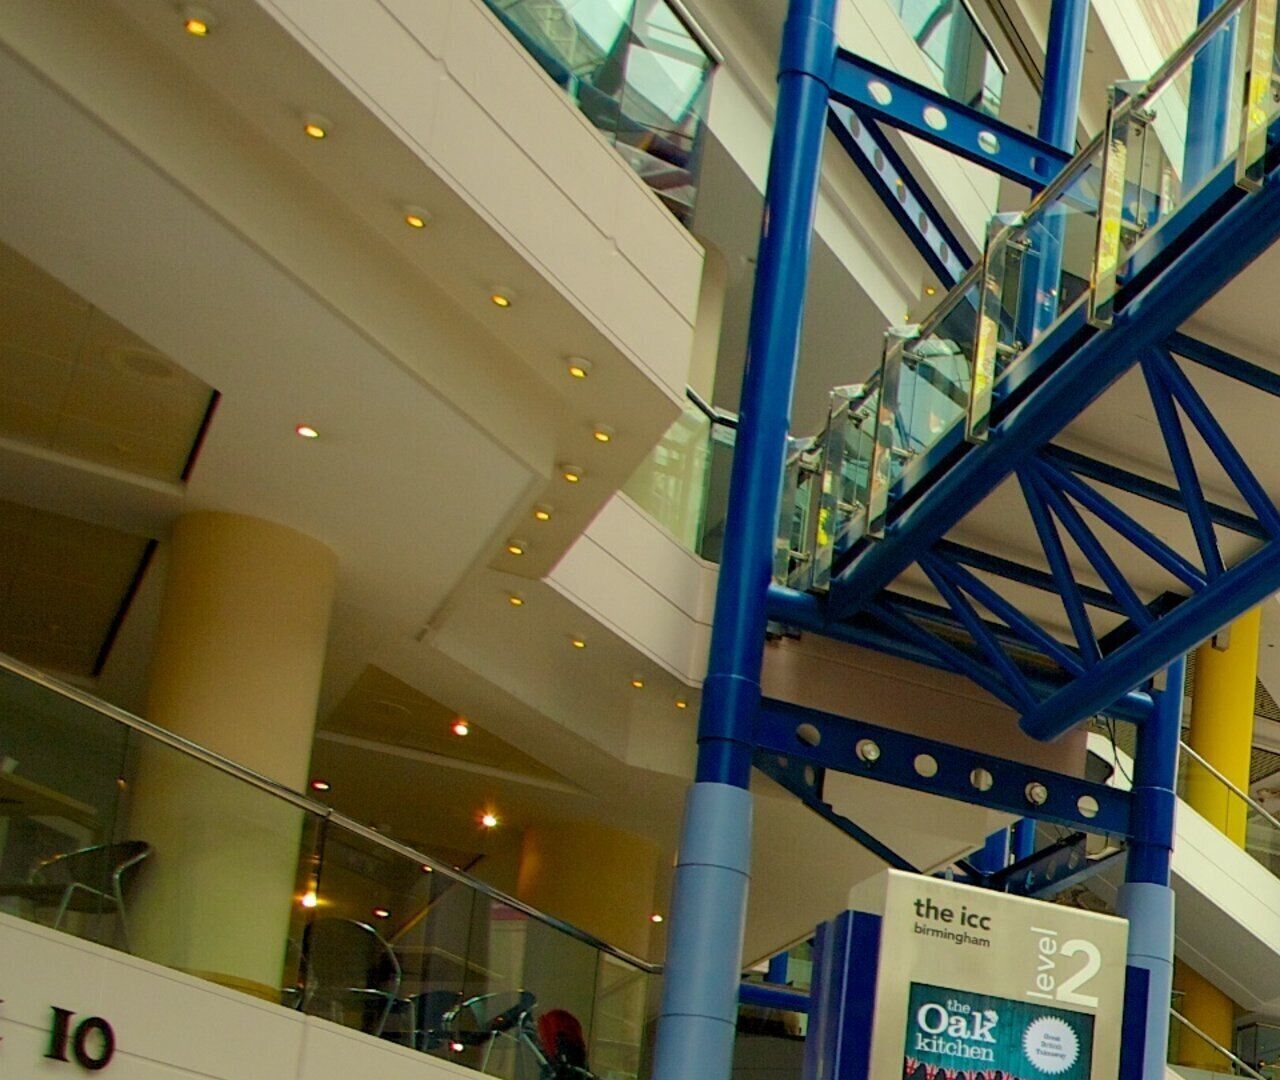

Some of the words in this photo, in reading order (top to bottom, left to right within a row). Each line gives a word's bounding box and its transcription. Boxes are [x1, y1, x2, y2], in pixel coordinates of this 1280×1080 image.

[914, 897, 955, 924] the
[960, 904, 992, 931] icc
[914, 922, 991, 948] birmingham
[1027, 926, 1059, 1000] level
[1056, 939, 1102, 1007] 2
[917, 1001, 998, 1045] Oak
[947, 999, 971, 1016] the
[915, 1033, 995, 1063] kitchen
